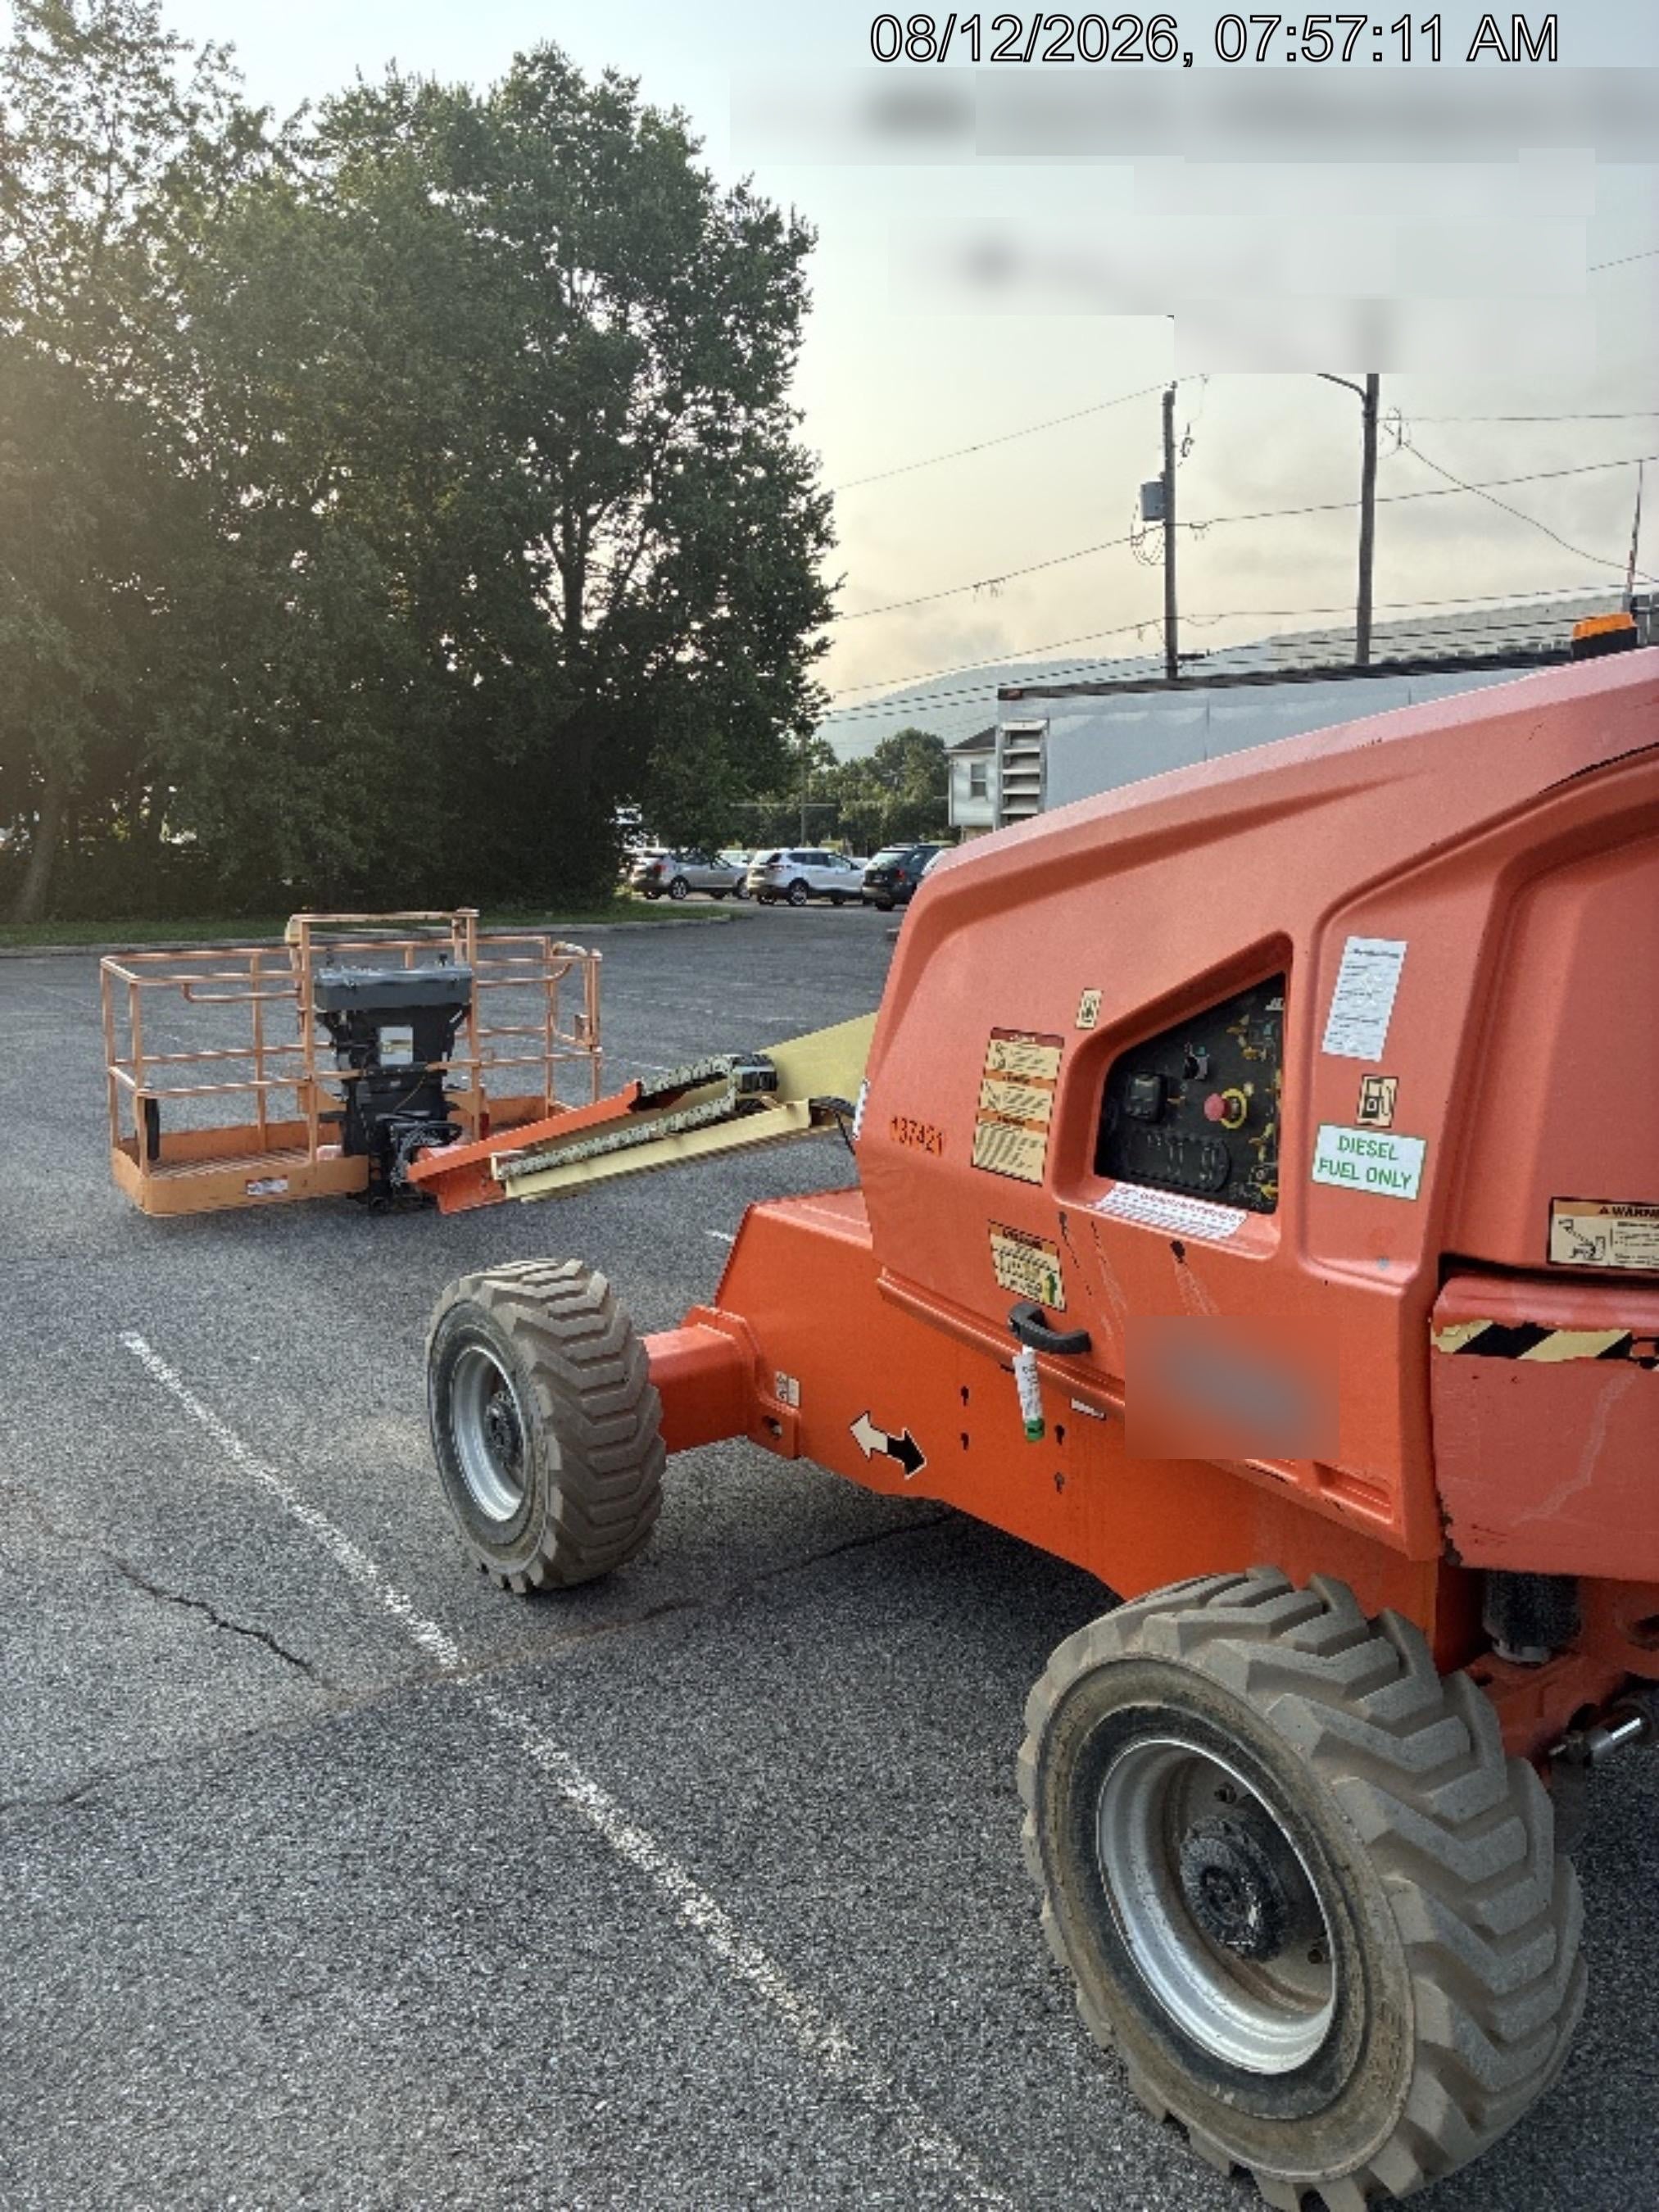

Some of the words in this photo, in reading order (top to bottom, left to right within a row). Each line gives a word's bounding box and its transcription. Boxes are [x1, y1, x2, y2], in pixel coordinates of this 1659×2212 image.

[1336, 1135, 1398, 1161] DIESEL
[1317, 1157, 1360, 1181] FUEL
[1366, 1167, 1412, 1190] ONLY
